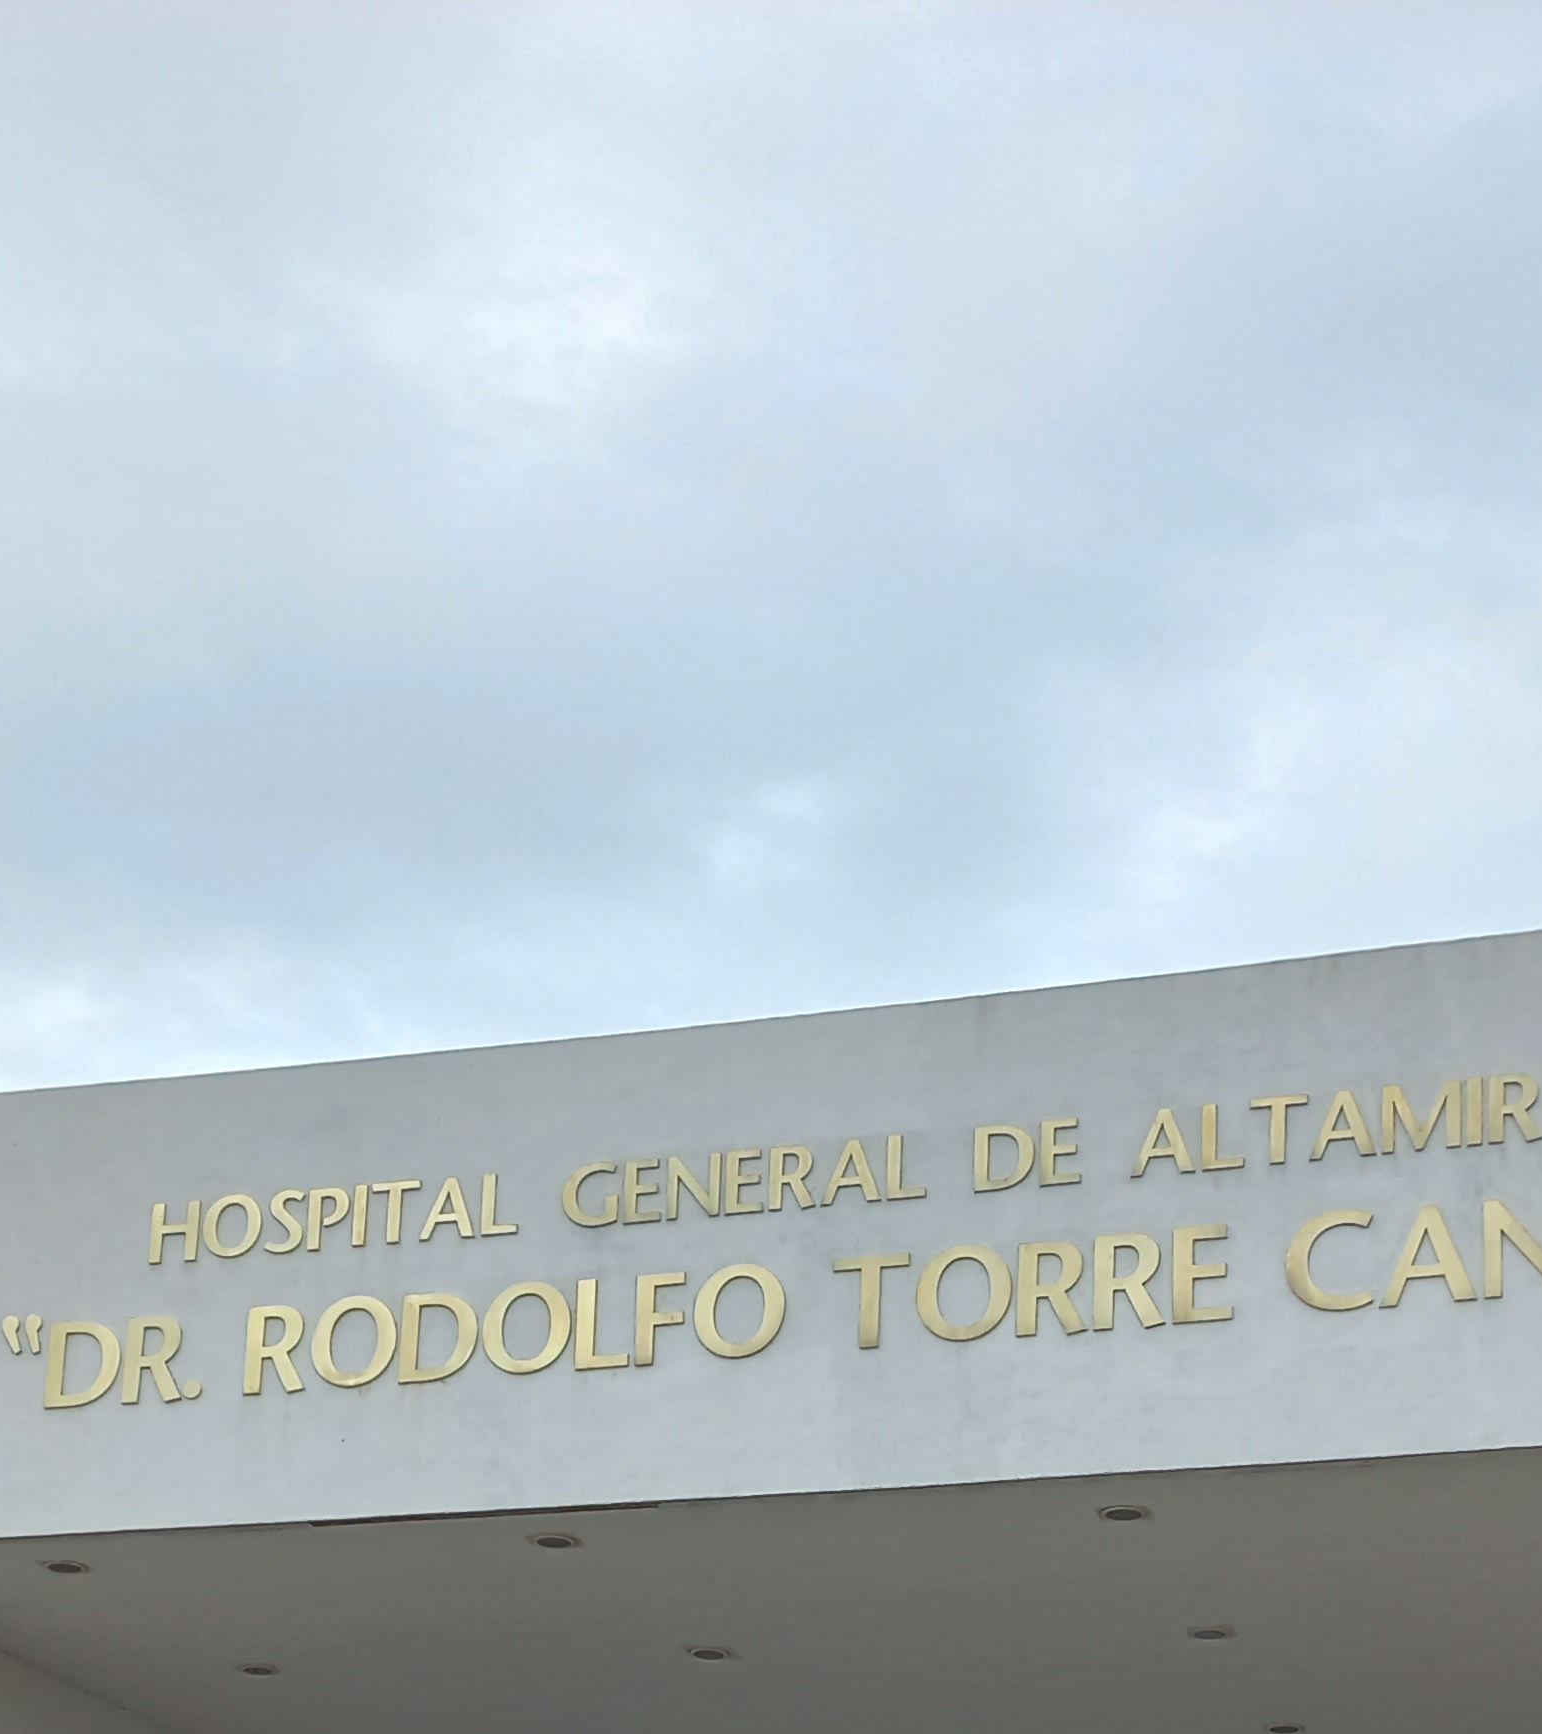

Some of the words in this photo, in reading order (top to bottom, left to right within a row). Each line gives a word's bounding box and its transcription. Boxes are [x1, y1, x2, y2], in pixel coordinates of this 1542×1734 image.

[148, 1172, 519, 1265] HOSPITAL
[562, 1134, 927, 1228] GENERAL
[973, 1117, 1082, 1193] DE
[243, 1263, 786, 1396] RODOLFO
[833, 1223, 1234, 1349] TORRE
